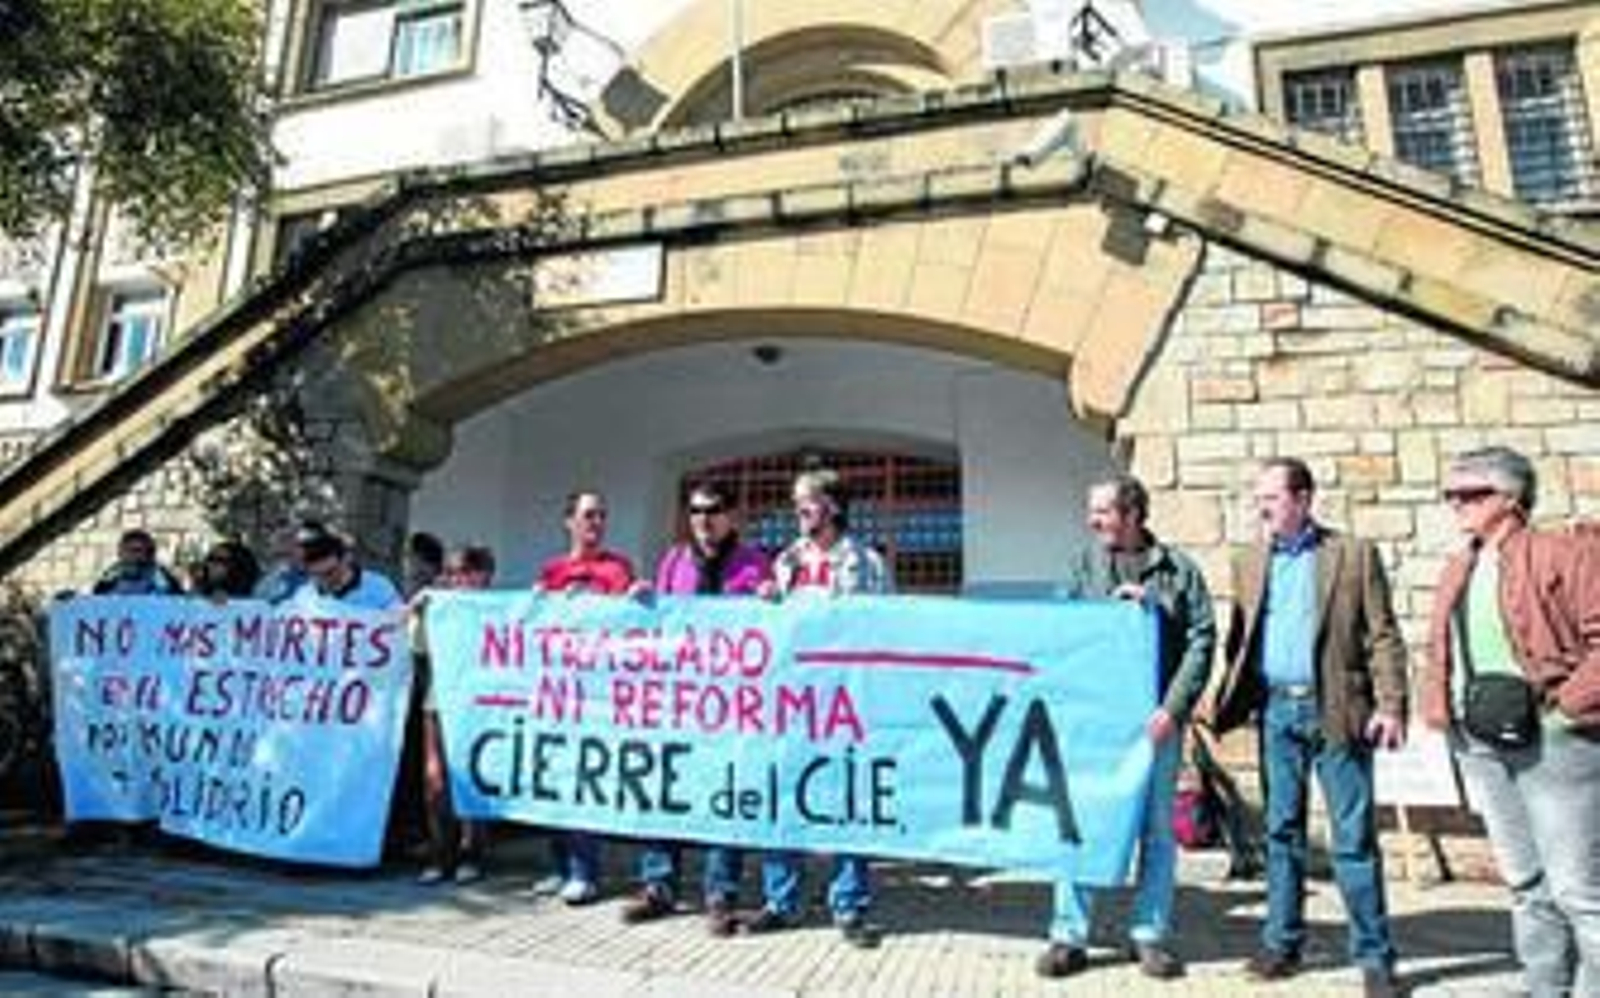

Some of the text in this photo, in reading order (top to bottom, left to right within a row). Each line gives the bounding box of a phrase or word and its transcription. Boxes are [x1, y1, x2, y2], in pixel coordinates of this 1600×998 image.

[75, 617, 134, 658] NO
[480, 618, 773, 678] NI TRASLADO
[534, 675, 866, 743] NI REFORMA
[469, 716, 694, 816] CIERRE
[709, 761, 779, 824] del
[928, 694, 1084, 845] YA
